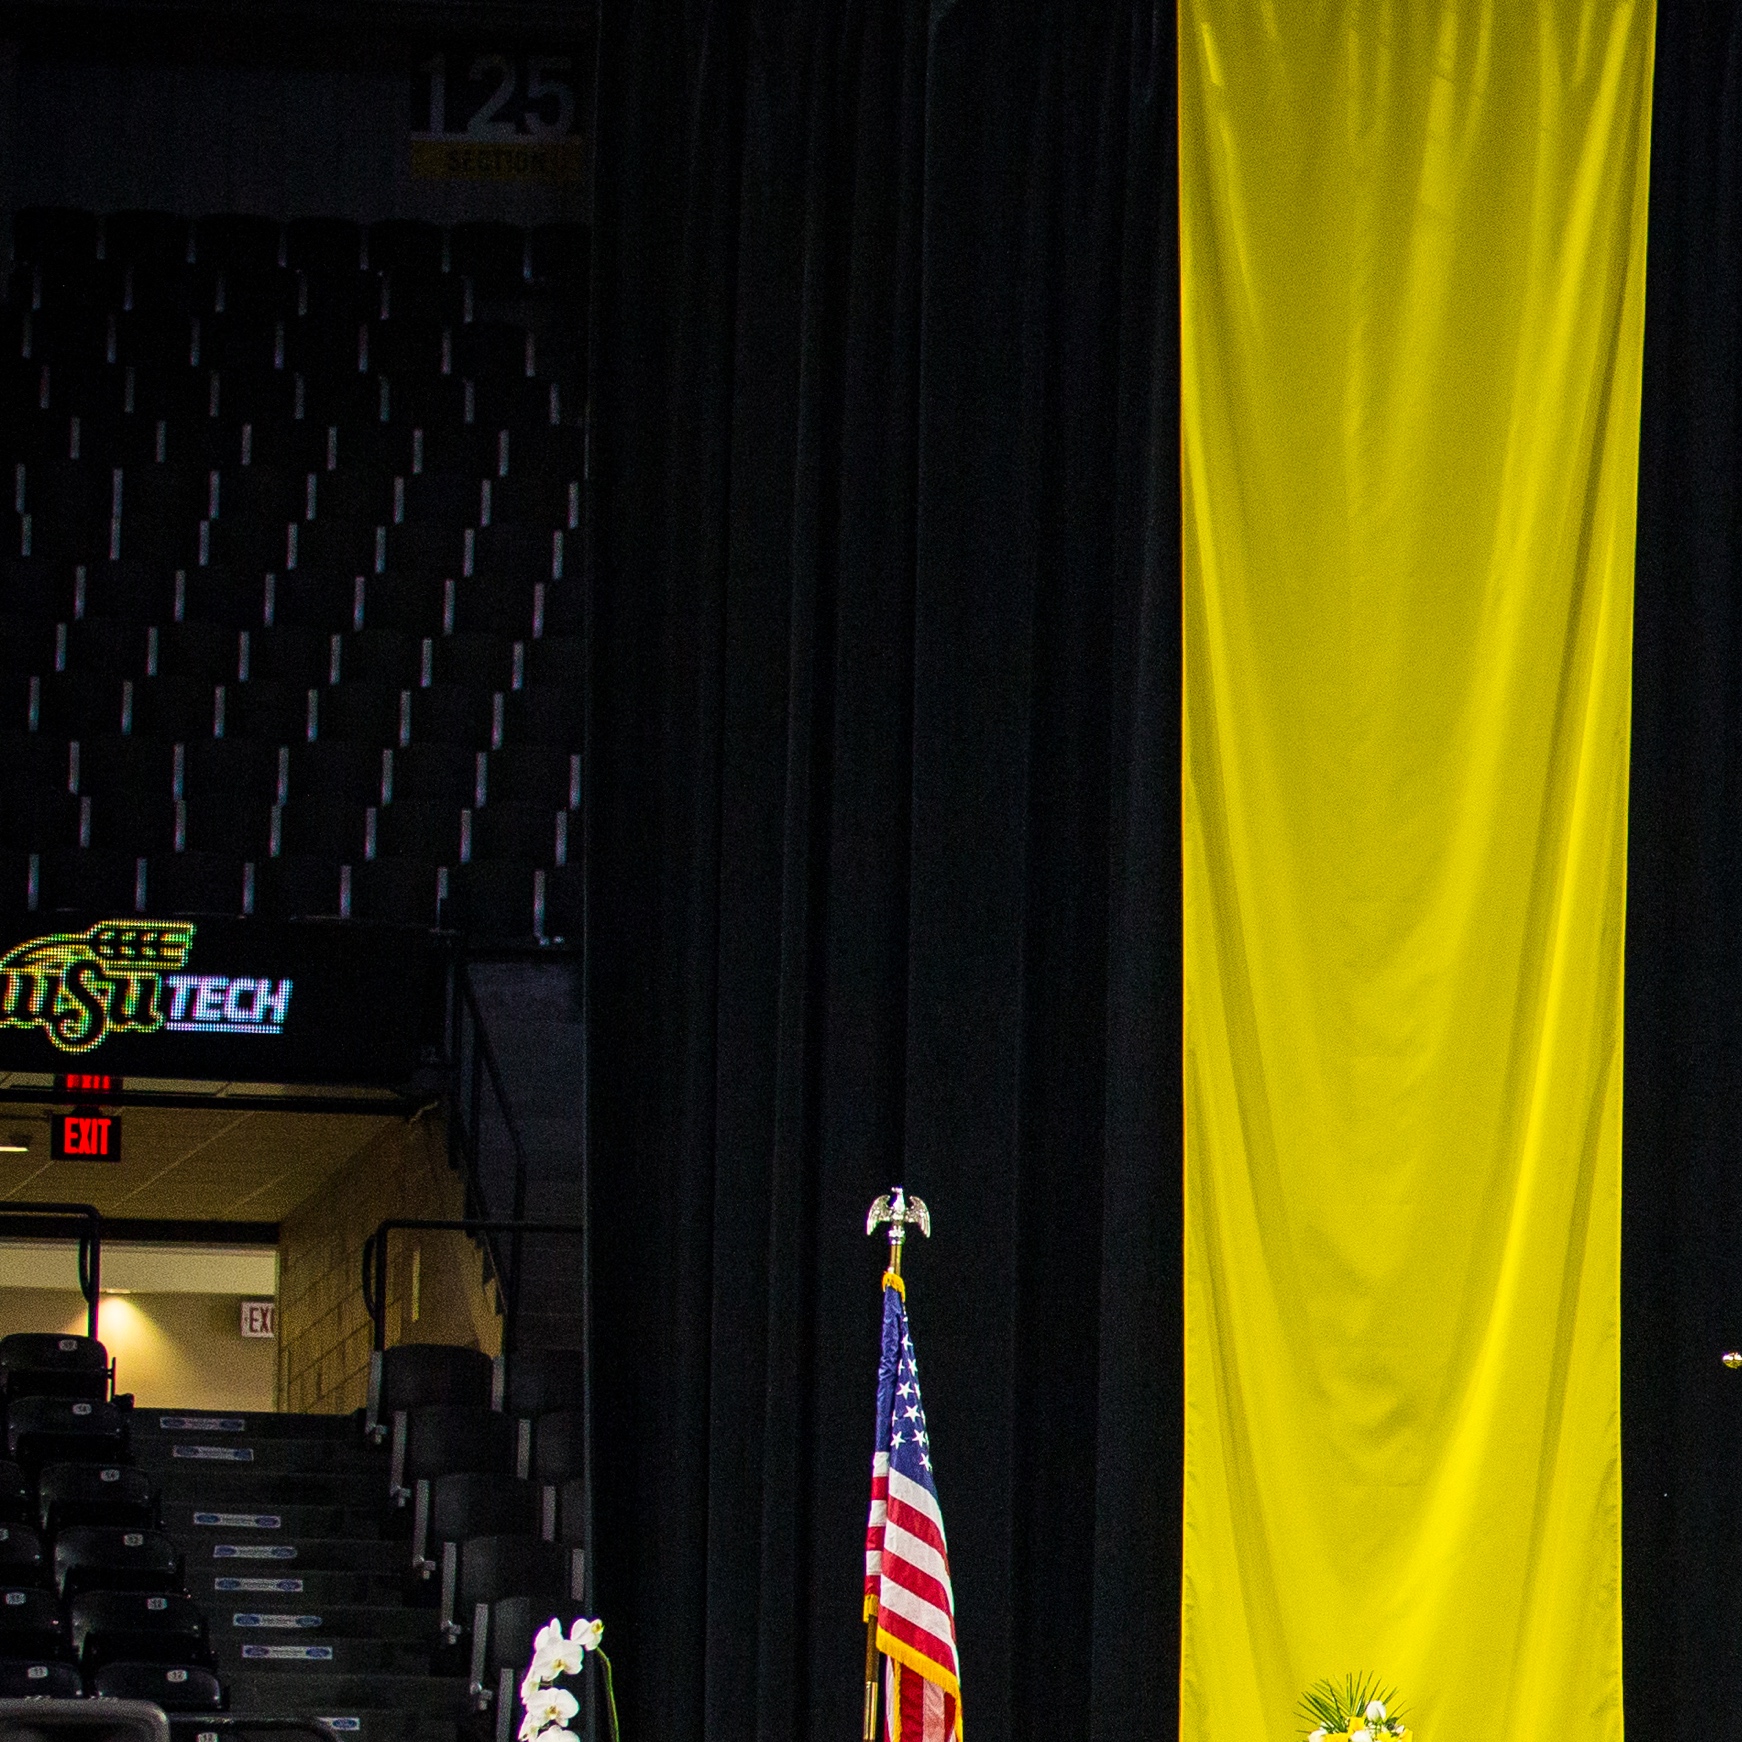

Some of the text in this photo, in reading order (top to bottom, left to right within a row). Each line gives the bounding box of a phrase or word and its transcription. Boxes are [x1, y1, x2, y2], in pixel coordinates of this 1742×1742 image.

[418, 52, 574, 138] 125
[165, 975, 293, 1024] TECH
[64, 1117, 111, 1155] EXIT
